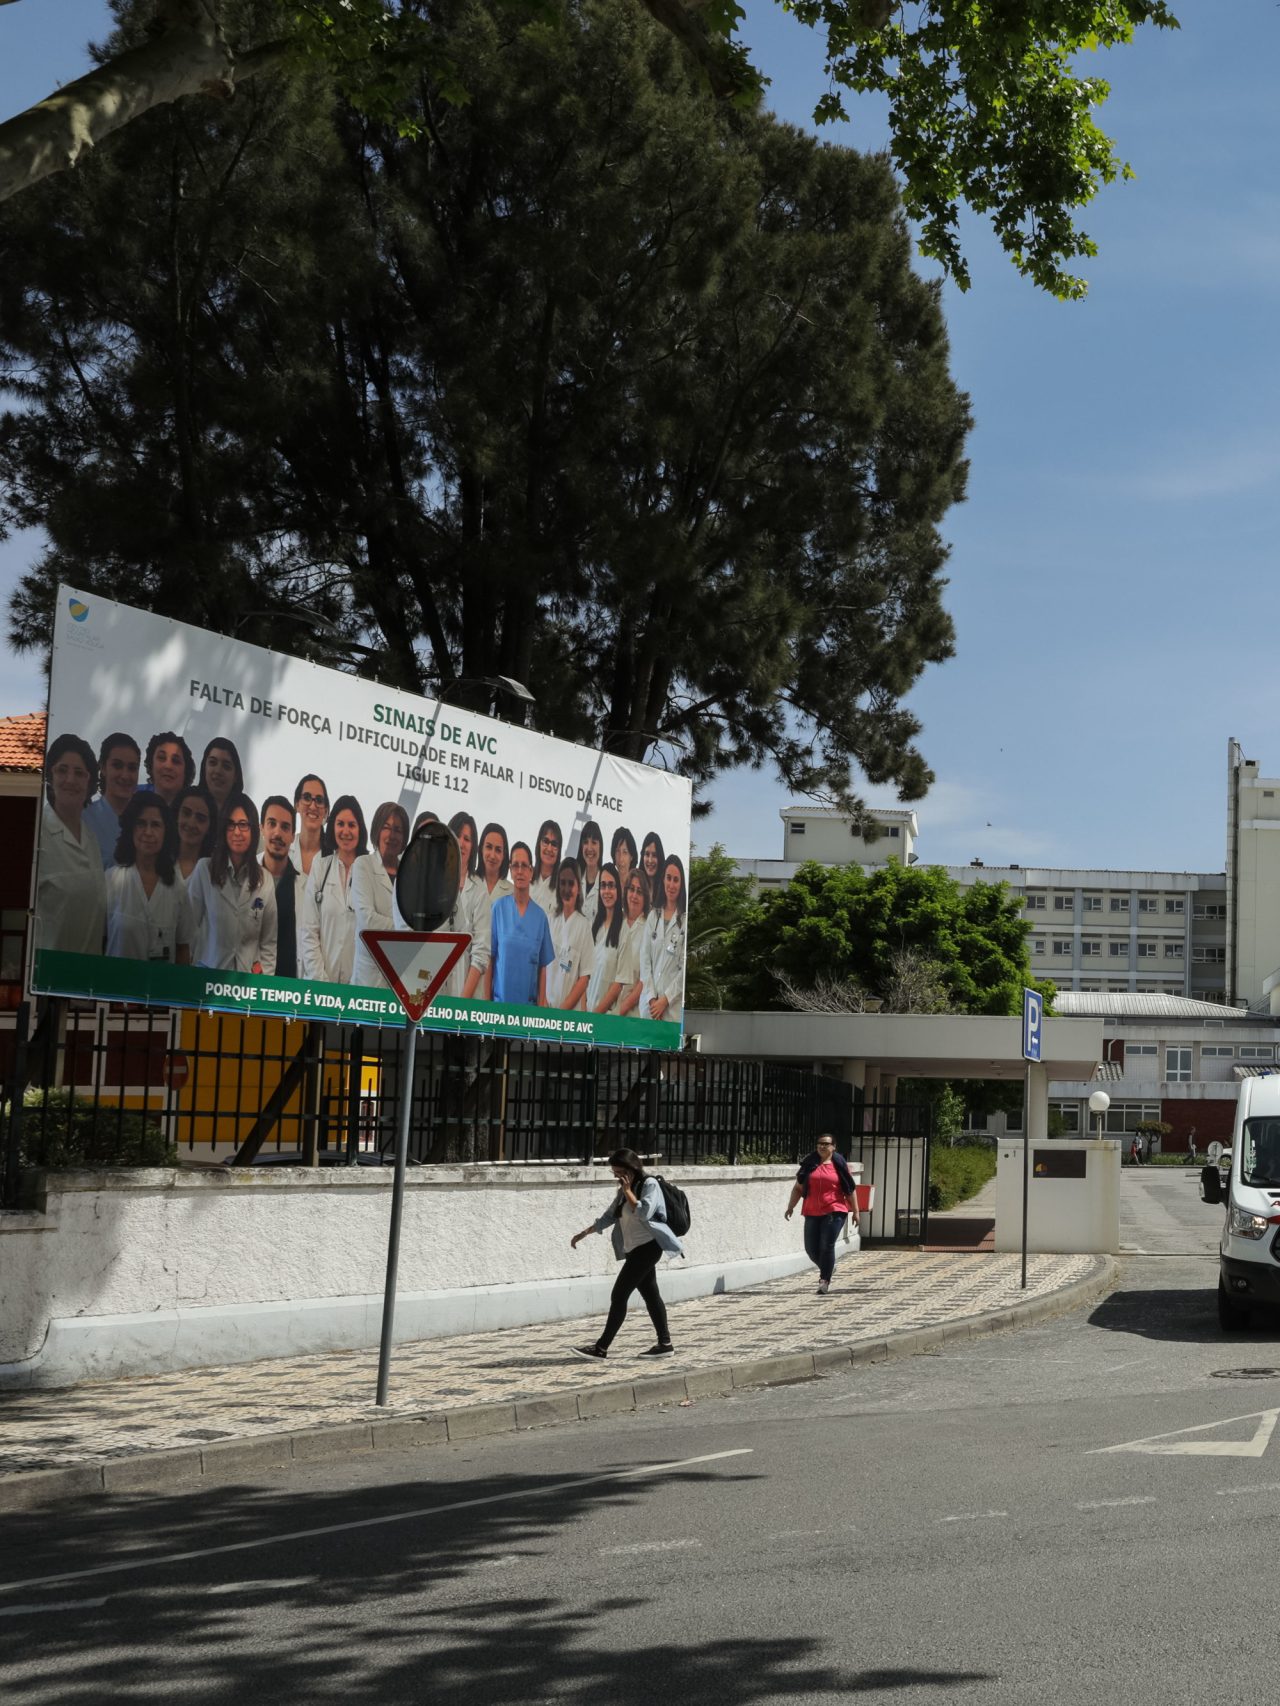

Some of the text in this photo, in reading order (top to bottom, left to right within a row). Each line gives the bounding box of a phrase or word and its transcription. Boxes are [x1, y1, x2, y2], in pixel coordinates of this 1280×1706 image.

[190, 680, 245, 710] FALTA
[250, 697, 273, 718] DE
[278, 705, 332, 734] FORÇA
[346, 724, 447, 765] DIFICULDADE
[450, 753, 470, 771] EM
[473, 759, 514, 783] FALAR
[529, 774, 574, 799] DESVIO
[577, 788, 593, 804] DA
[596, 793, 623, 812] FACE
[373, 704, 497, 755] SINAIS DE AVC
[397, 761, 469, 794] LIGUE 112
[205, 982, 594, 1034] PORQUE TEMPO É VIDA, ACEITE O CELHO DA EQUIPA DA UNIDADE DE AVC
[1027, 997, 1038, 1051] P
